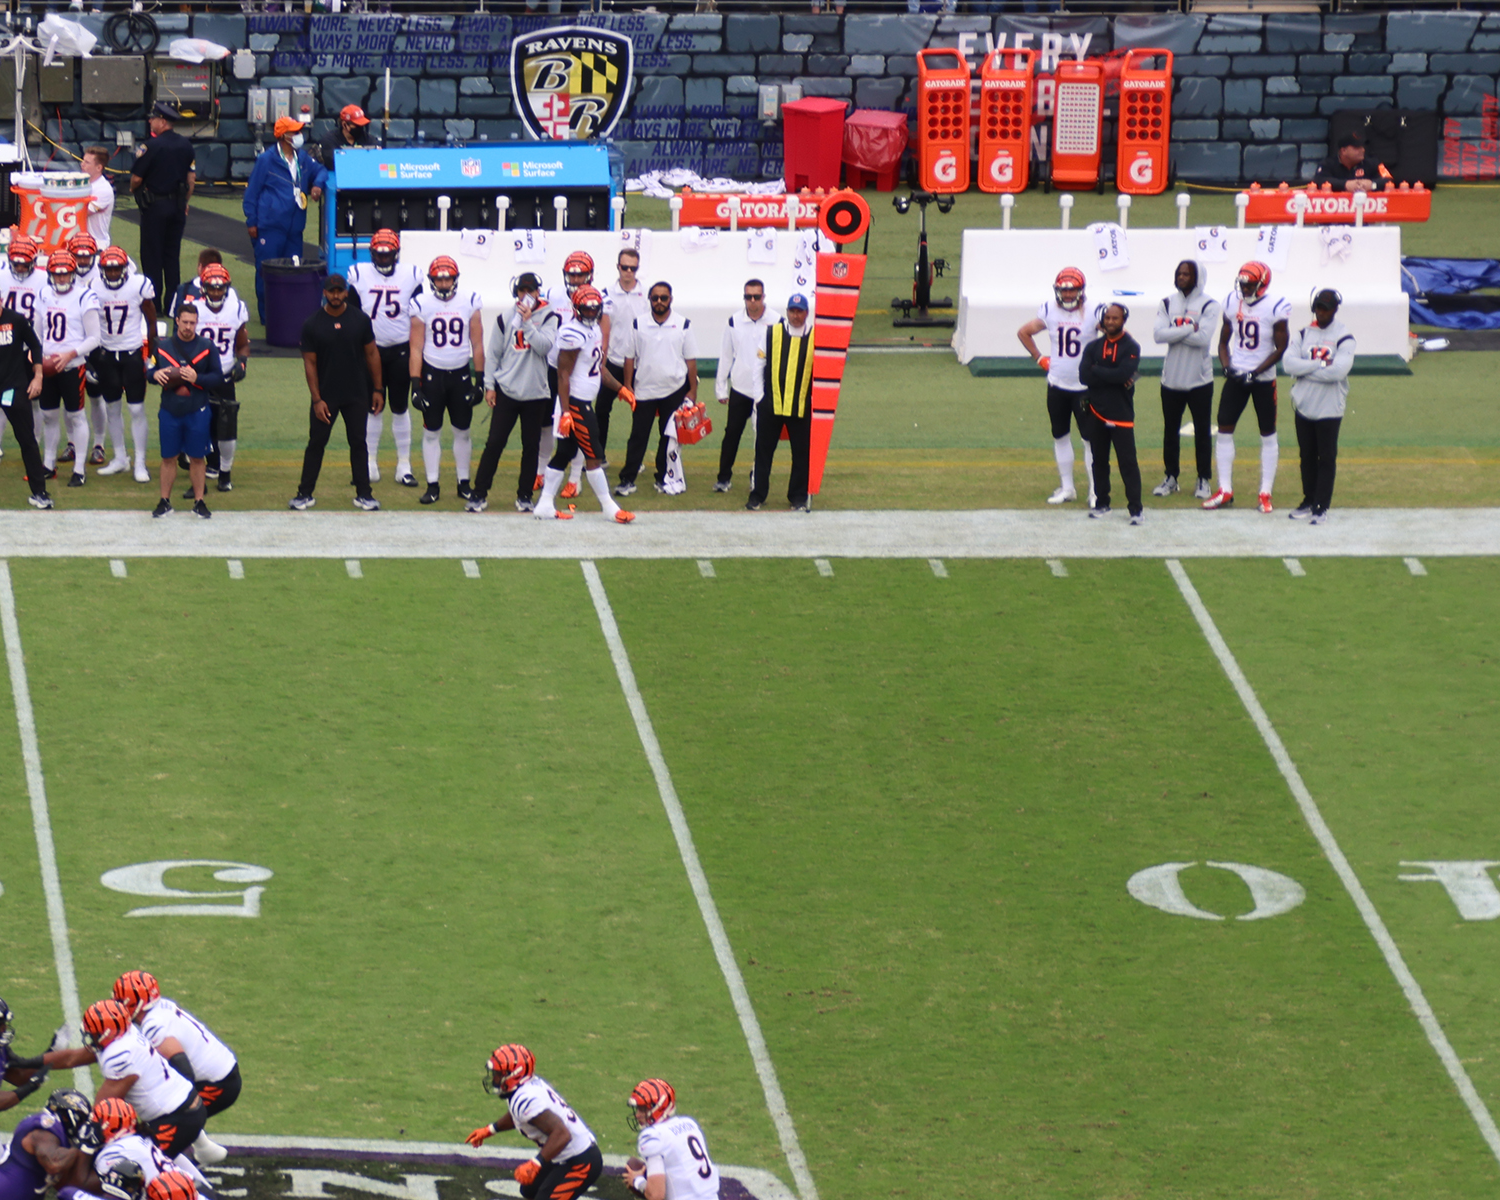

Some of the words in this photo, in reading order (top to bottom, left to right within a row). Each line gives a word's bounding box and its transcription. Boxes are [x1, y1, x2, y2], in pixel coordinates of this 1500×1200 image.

[249, 16, 306, 32] ALWAYS
[309, 16, 351, 32] MORE.
[357, 16, 402, 32] NEVER
[407, 16, 445, 32] LESS.
[610, 16, 649, 32] LESS.
[405, 34, 452, 50] NEVER
[525, 37, 618, 55] RAVENS
[958, 32, 1093, 70] EVERY
[430, 53, 468, 69] LESS.
[925, 79, 966, 89] GATORADE
[984, 79, 1026, 89] GATORADE
[1123, 80, 1166, 90] GATORADE
[400, 163, 440, 171] Microsoft
[400, 171, 433, 179] Surface
[523, 161, 563, 170] Microsoft
[523, 170, 556, 178] Surface
[934, 157, 956, 183] G
[990, 156, 1013, 183] G
[1130, 158, 1153, 184] G
[4, 292, 35, 321] 49
[369, 289, 401, 320] 75
[46, 312, 66, 342] 10
[103, 305, 129, 335] 17
[431, 317, 464, 348] 89
[1056, 326, 1082, 358] 16
[1237, 319, 1260, 350] 19
[588, 347, 603, 377] 2
[687, 1135, 711, 1179] 9
